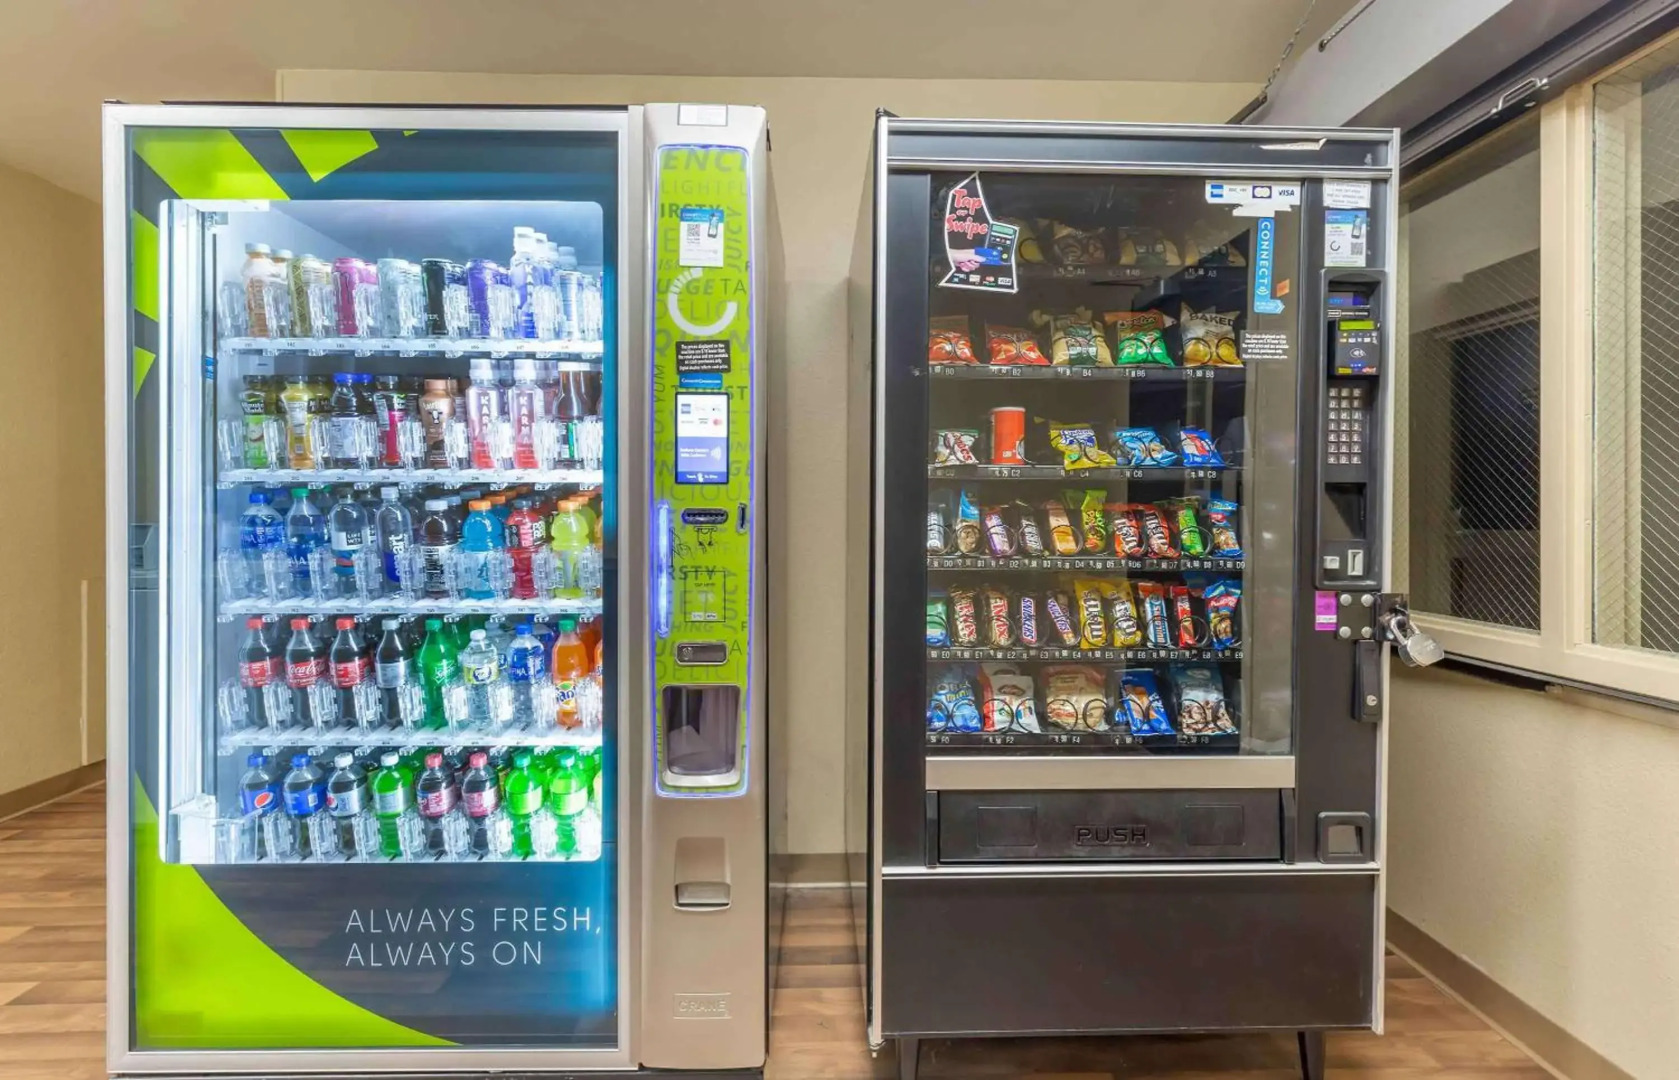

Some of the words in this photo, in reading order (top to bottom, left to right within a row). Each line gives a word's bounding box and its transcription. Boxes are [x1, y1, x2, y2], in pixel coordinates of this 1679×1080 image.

[953, 189, 983, 215] Tap
[946, 213, 988, 240] Swipe
[1257, 221, 1272, 284] CONNECT
[1011, 469, 1020, 477] C2
[1133, 470, 1143, 478] C6
[1009, 560, 1019, 568] D2
[1236, 561, 1246, 569] D9
[1022, 597, 1035, 640] SNICKERS
[1170, 651, 1179, 659] E7
[1235, 651, 1244, 659] E9
[941, 736, 950, 744] F0
[1005, 736, 1015, 744] F2
[1076, 826, 1147, 844] PUSH
[345, 908, 475, 933] ALWAYS
[494, 907, 601, 934] FRESH,
[345, 941, 475, 966] ALWAYS
[492, 940, 542, 966] ON
